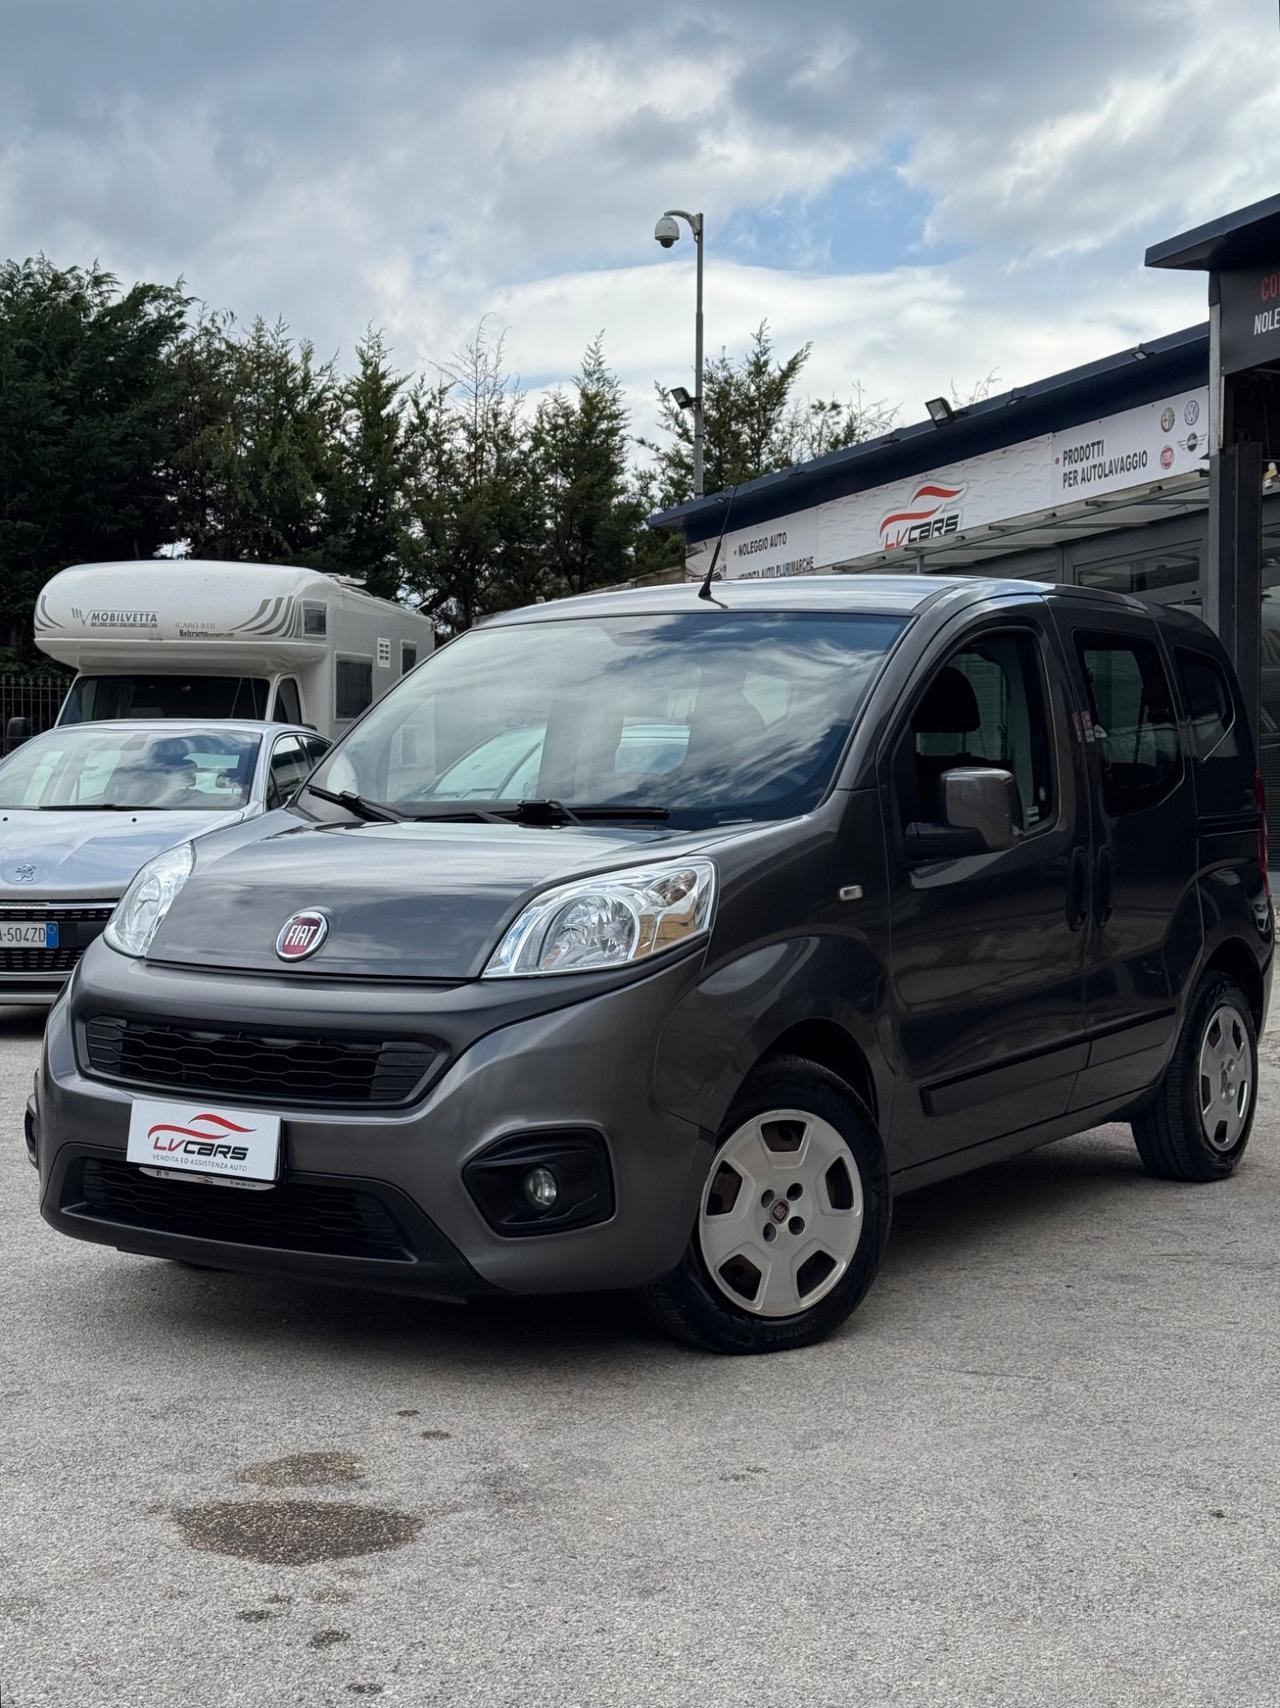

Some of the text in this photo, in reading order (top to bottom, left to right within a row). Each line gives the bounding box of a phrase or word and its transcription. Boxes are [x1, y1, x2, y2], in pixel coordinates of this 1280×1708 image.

[1261, 273, 1280, 300] CO
[1063, 439, 1104, 467] PRODOTTI
[1063, 468, 1078, 489] PER
[1080, 450, 1148, 484] AUTOLAVAGGIO
[738, 532, 787, 557] NOLEGGIO AUTO
[775, 556, 814, 577] PLURIMARCHE
[91, 612, 157, 623] MOBILVETTA
[284, 924, 318, 946] FIAT
[152, 1153, 247, 1172] VENDITA ED ASSISTENZA AUTO
